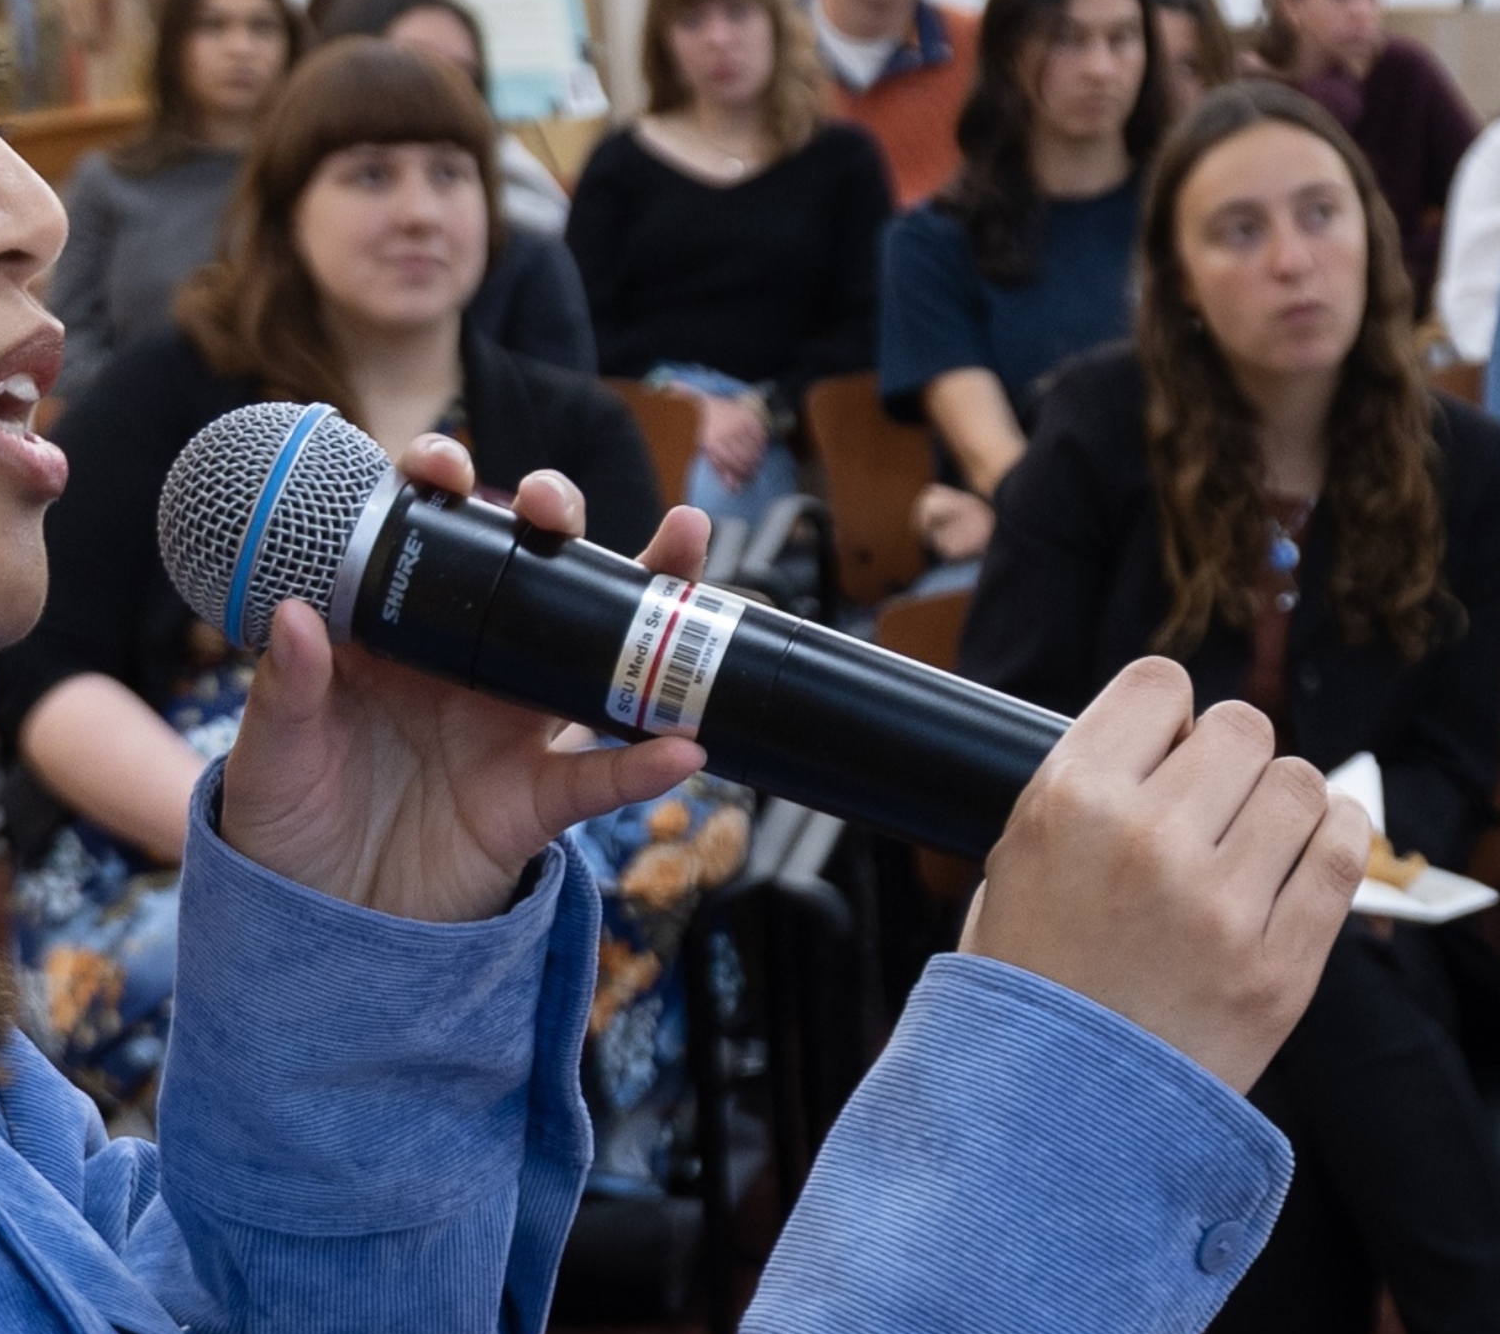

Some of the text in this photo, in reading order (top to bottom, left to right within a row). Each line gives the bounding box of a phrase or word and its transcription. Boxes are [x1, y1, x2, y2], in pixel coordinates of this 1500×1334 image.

[381, 535, 424, 625] SHURE
[617, 580, 680, 714] SCU Media Serces
